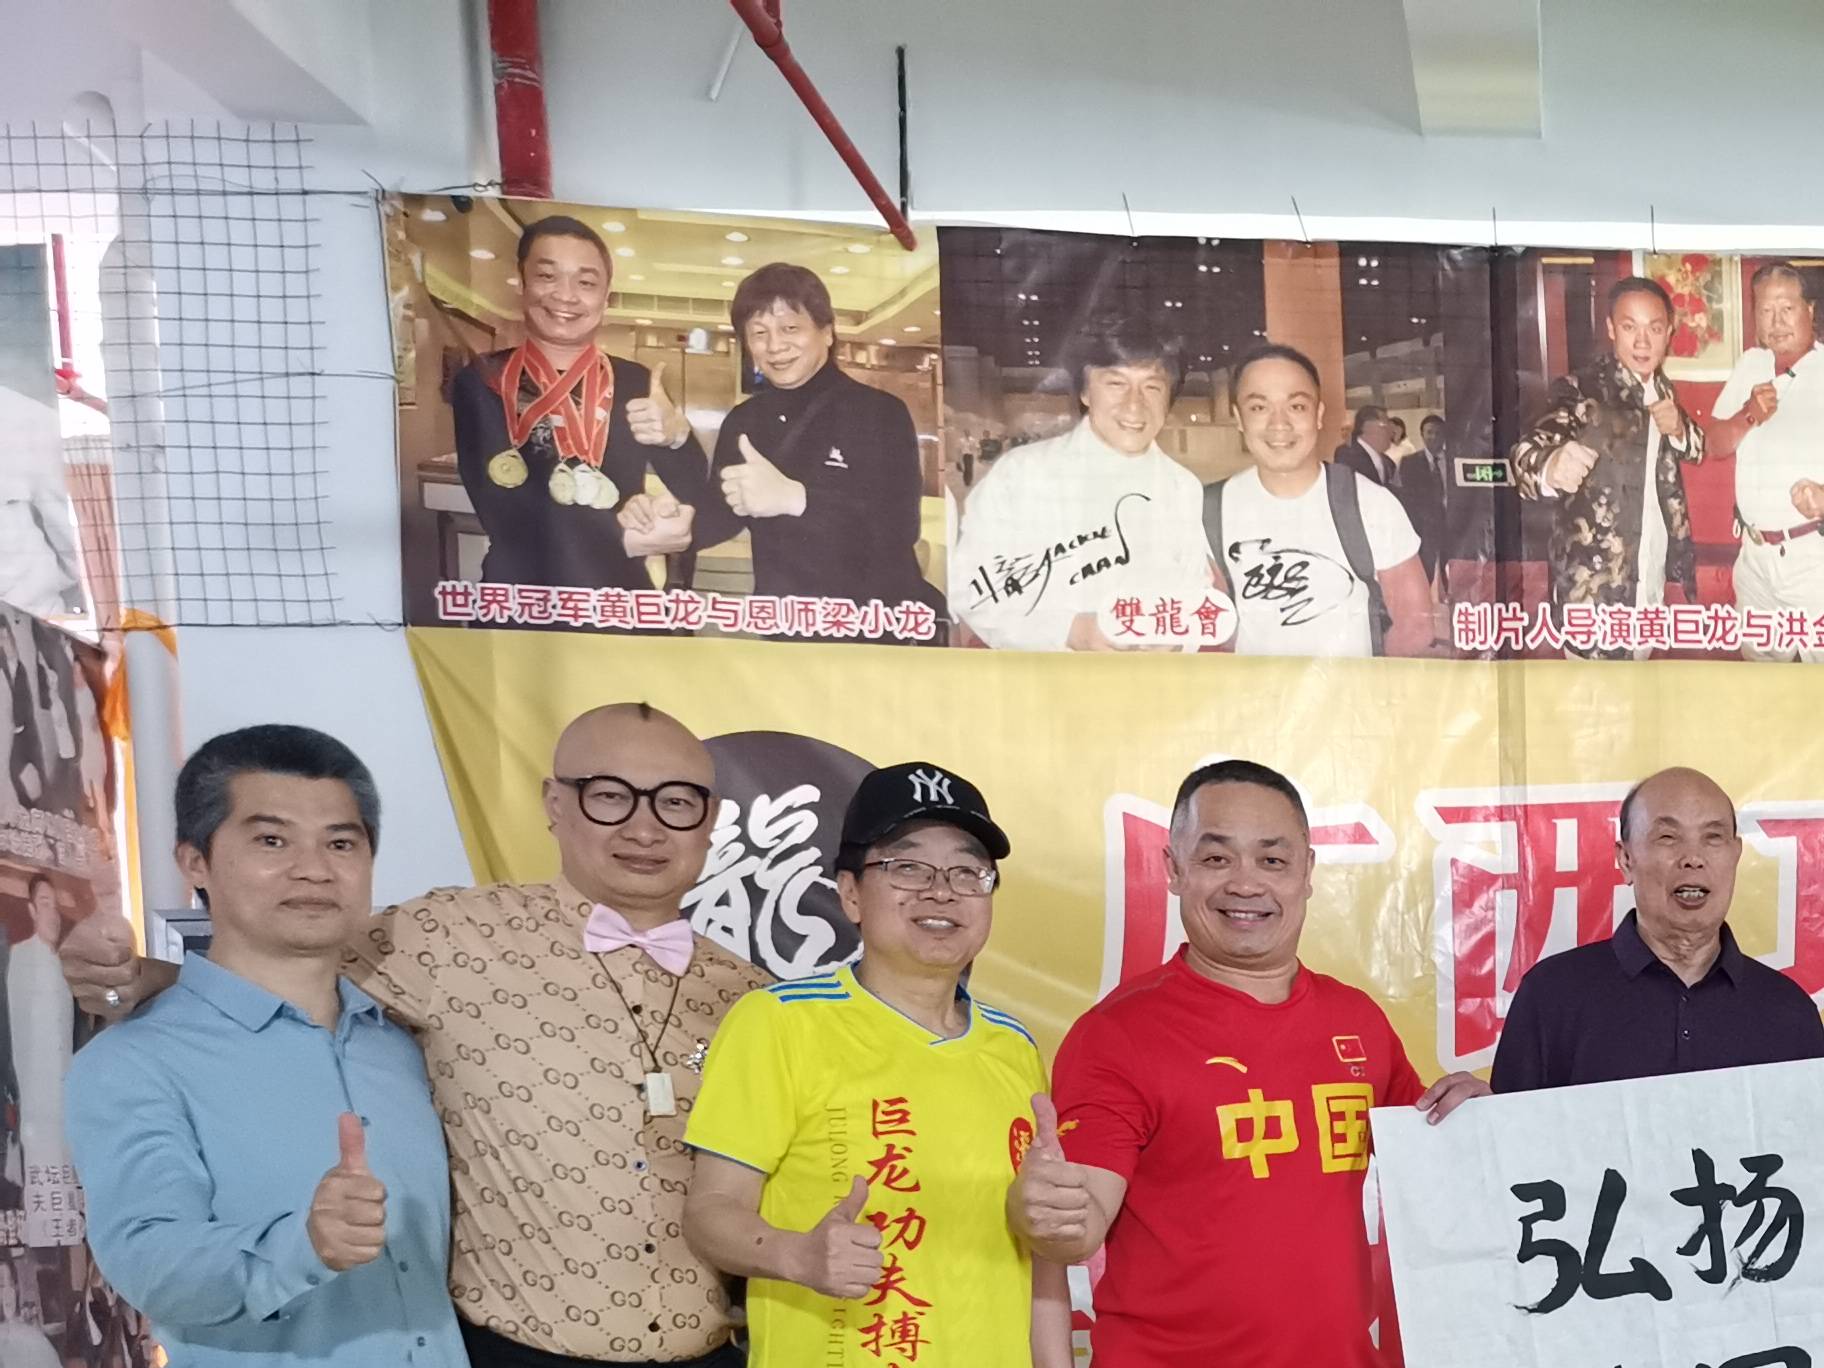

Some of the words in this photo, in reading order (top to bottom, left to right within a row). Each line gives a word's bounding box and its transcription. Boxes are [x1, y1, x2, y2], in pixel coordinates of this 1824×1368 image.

[436, 582, 936, 639] 世界冠军黄巨龙与恩师梁小龙
[1110, 596, 1230, 639] 雙龍會
[907, 768, 954, 805] NY
[1216, 1082, 1374, 1179] 中国
